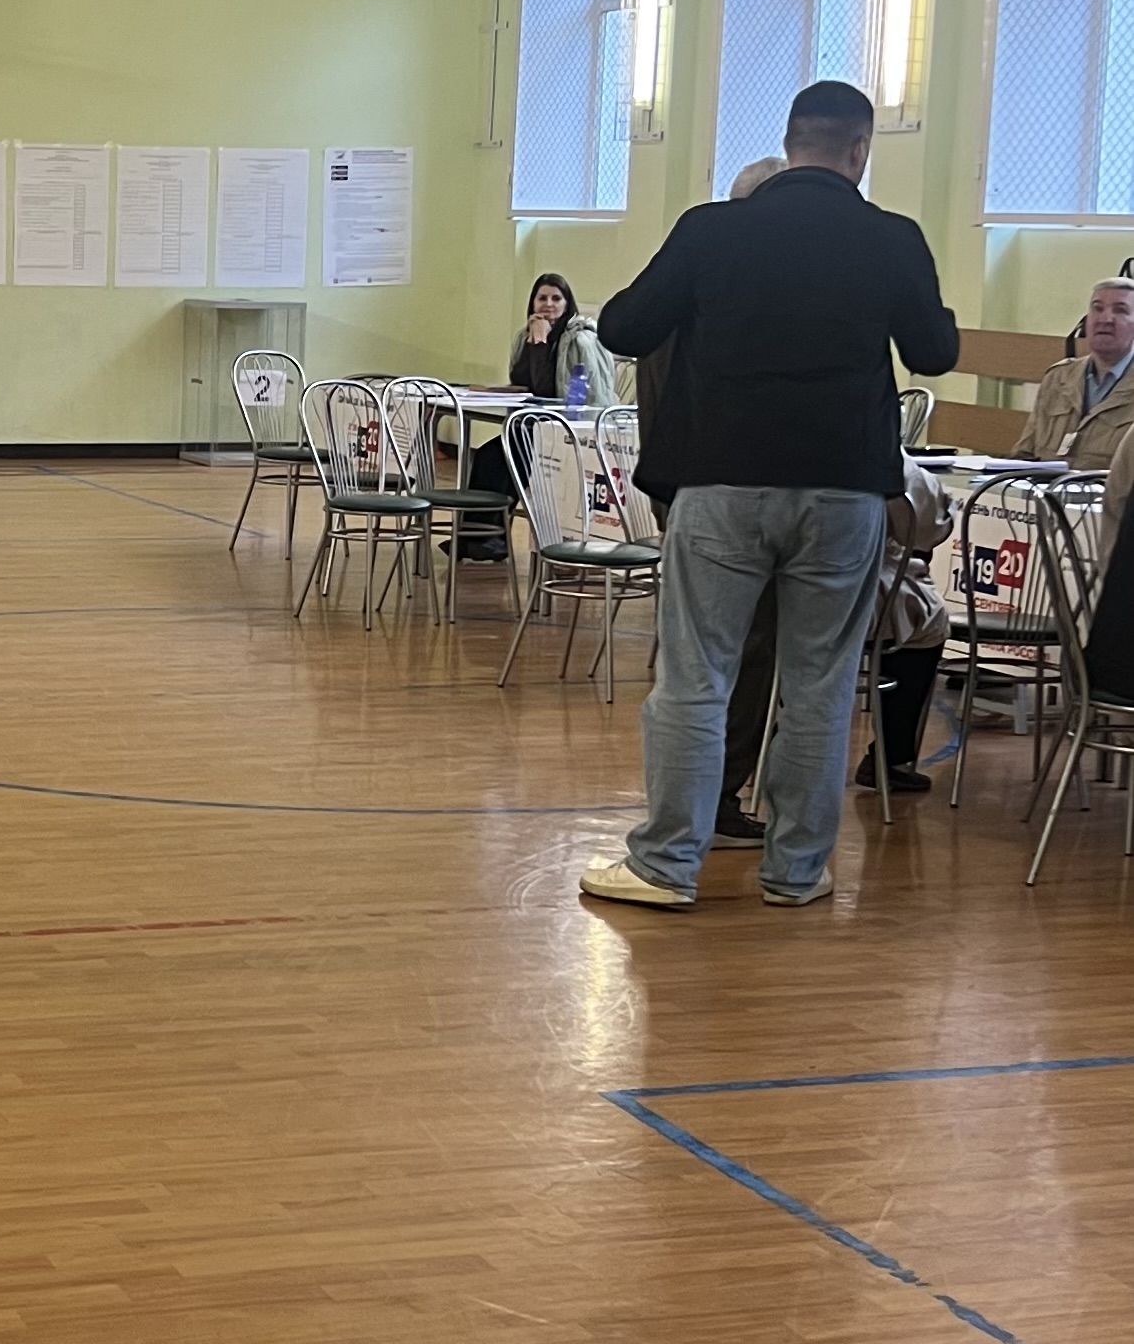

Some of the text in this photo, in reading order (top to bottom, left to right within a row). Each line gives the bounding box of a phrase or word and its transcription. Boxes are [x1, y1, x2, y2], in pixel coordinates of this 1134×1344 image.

[254, 375, 270, 402] 2
[595, 482, 607, 505] 19
[976, 558, 994, 585] 19
[998, 549, 1024, 578] 20
